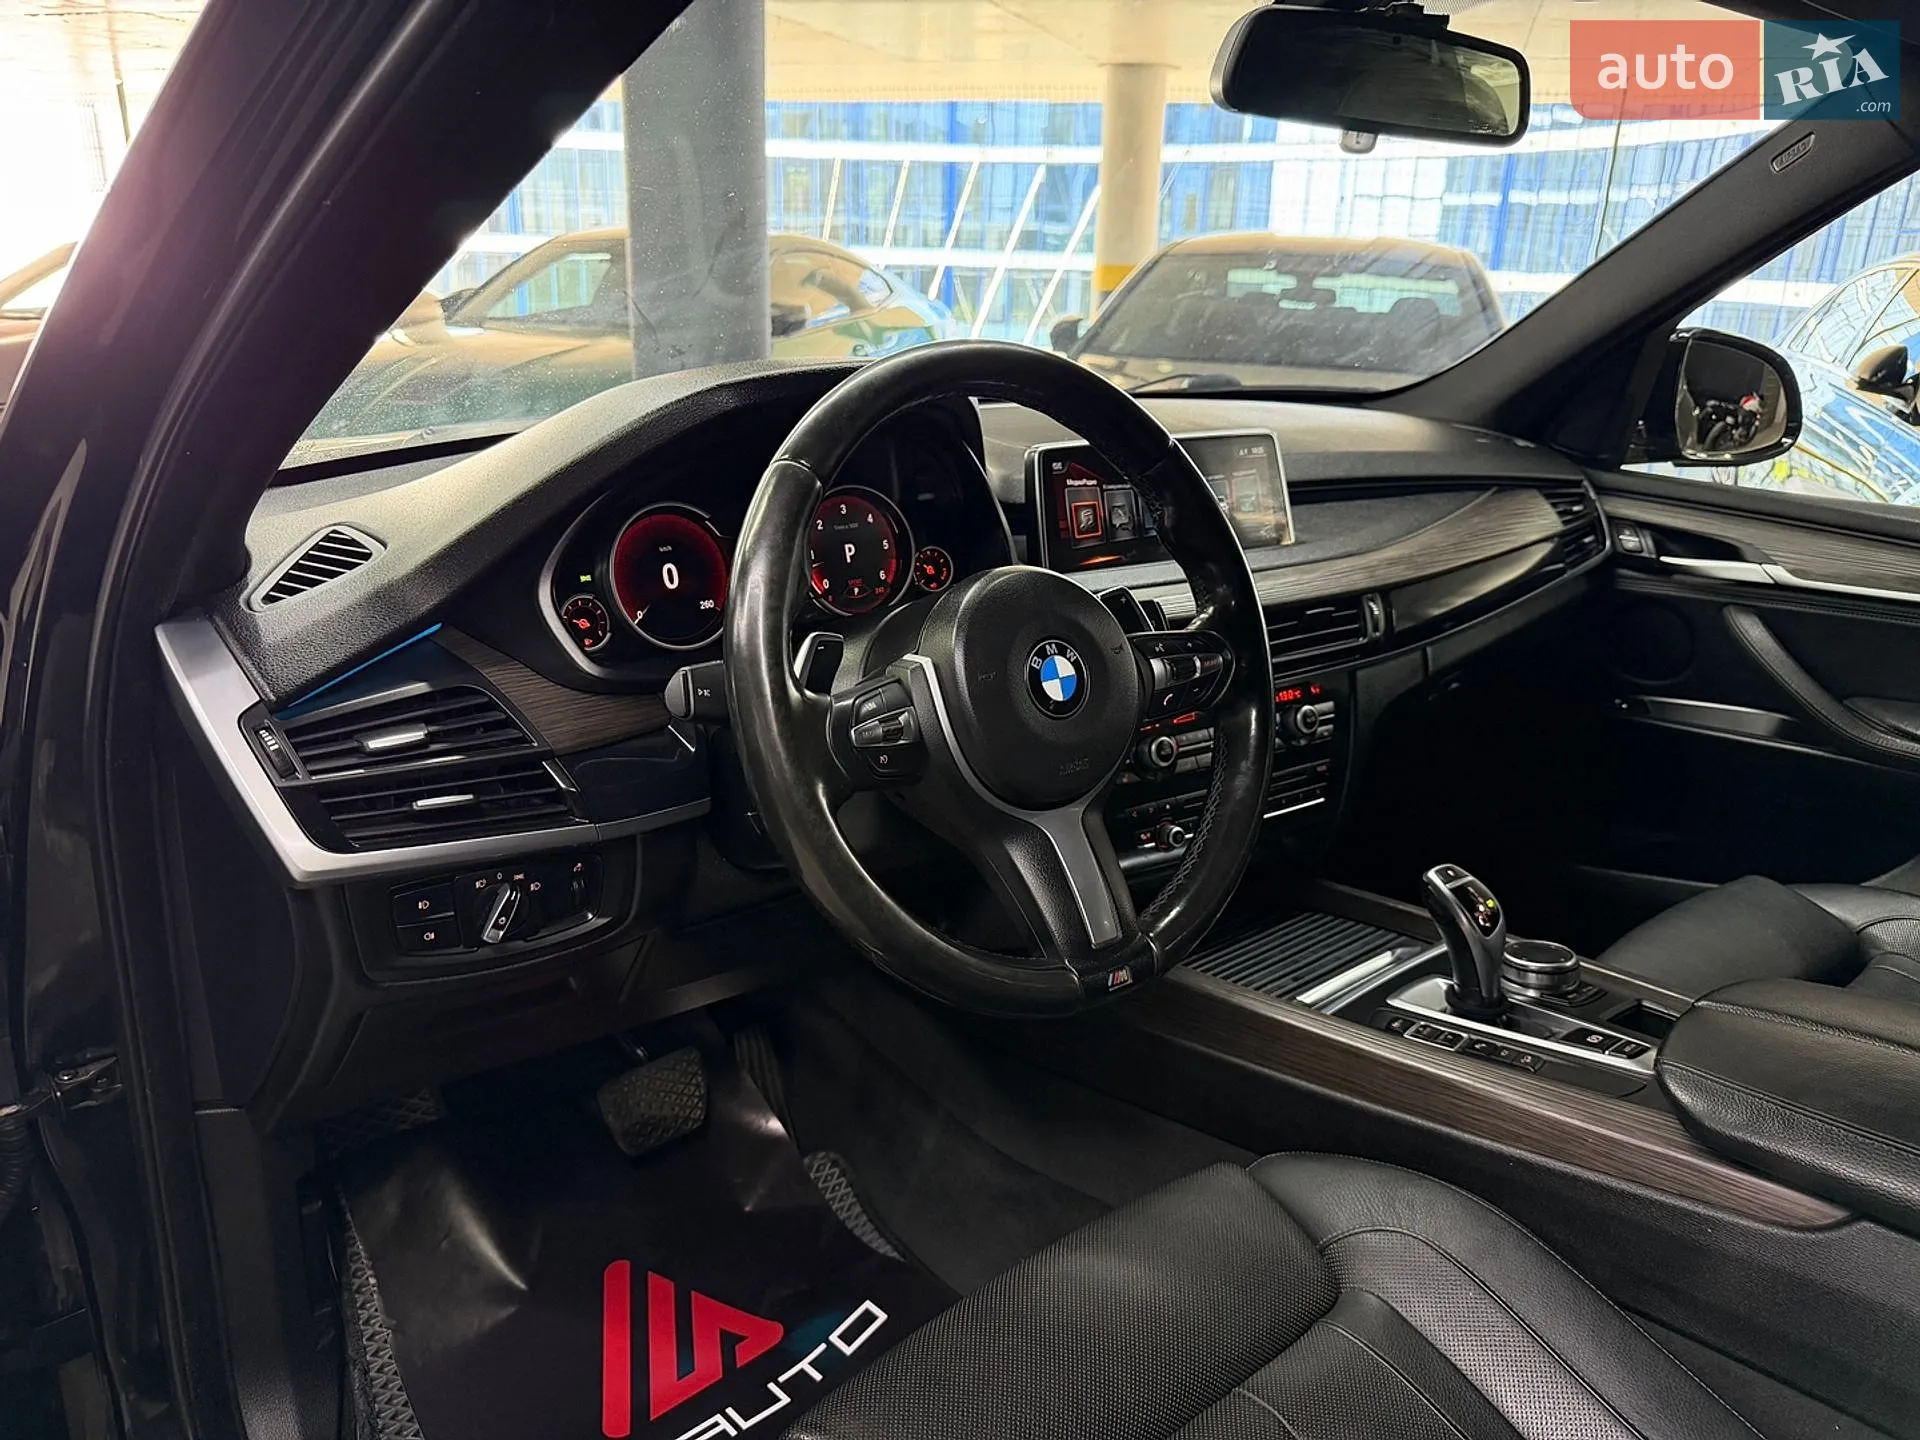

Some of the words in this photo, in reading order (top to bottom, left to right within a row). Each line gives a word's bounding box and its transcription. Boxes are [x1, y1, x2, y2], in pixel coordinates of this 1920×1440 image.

[840, 504, 847, 515] 3
[867, 513, 873, 523] 4
[816, 520, 823, 530] 2
[882, 540, 889, 550] 5
[844, 543, 855, 563] P
[662, 563, 679, 589] 0
[879, 570, 886, 580] 6
[823, 578, 829, 589] 0
[699, 599, 714, 610] 260
[1031, 643, 1077, 671] BMW
